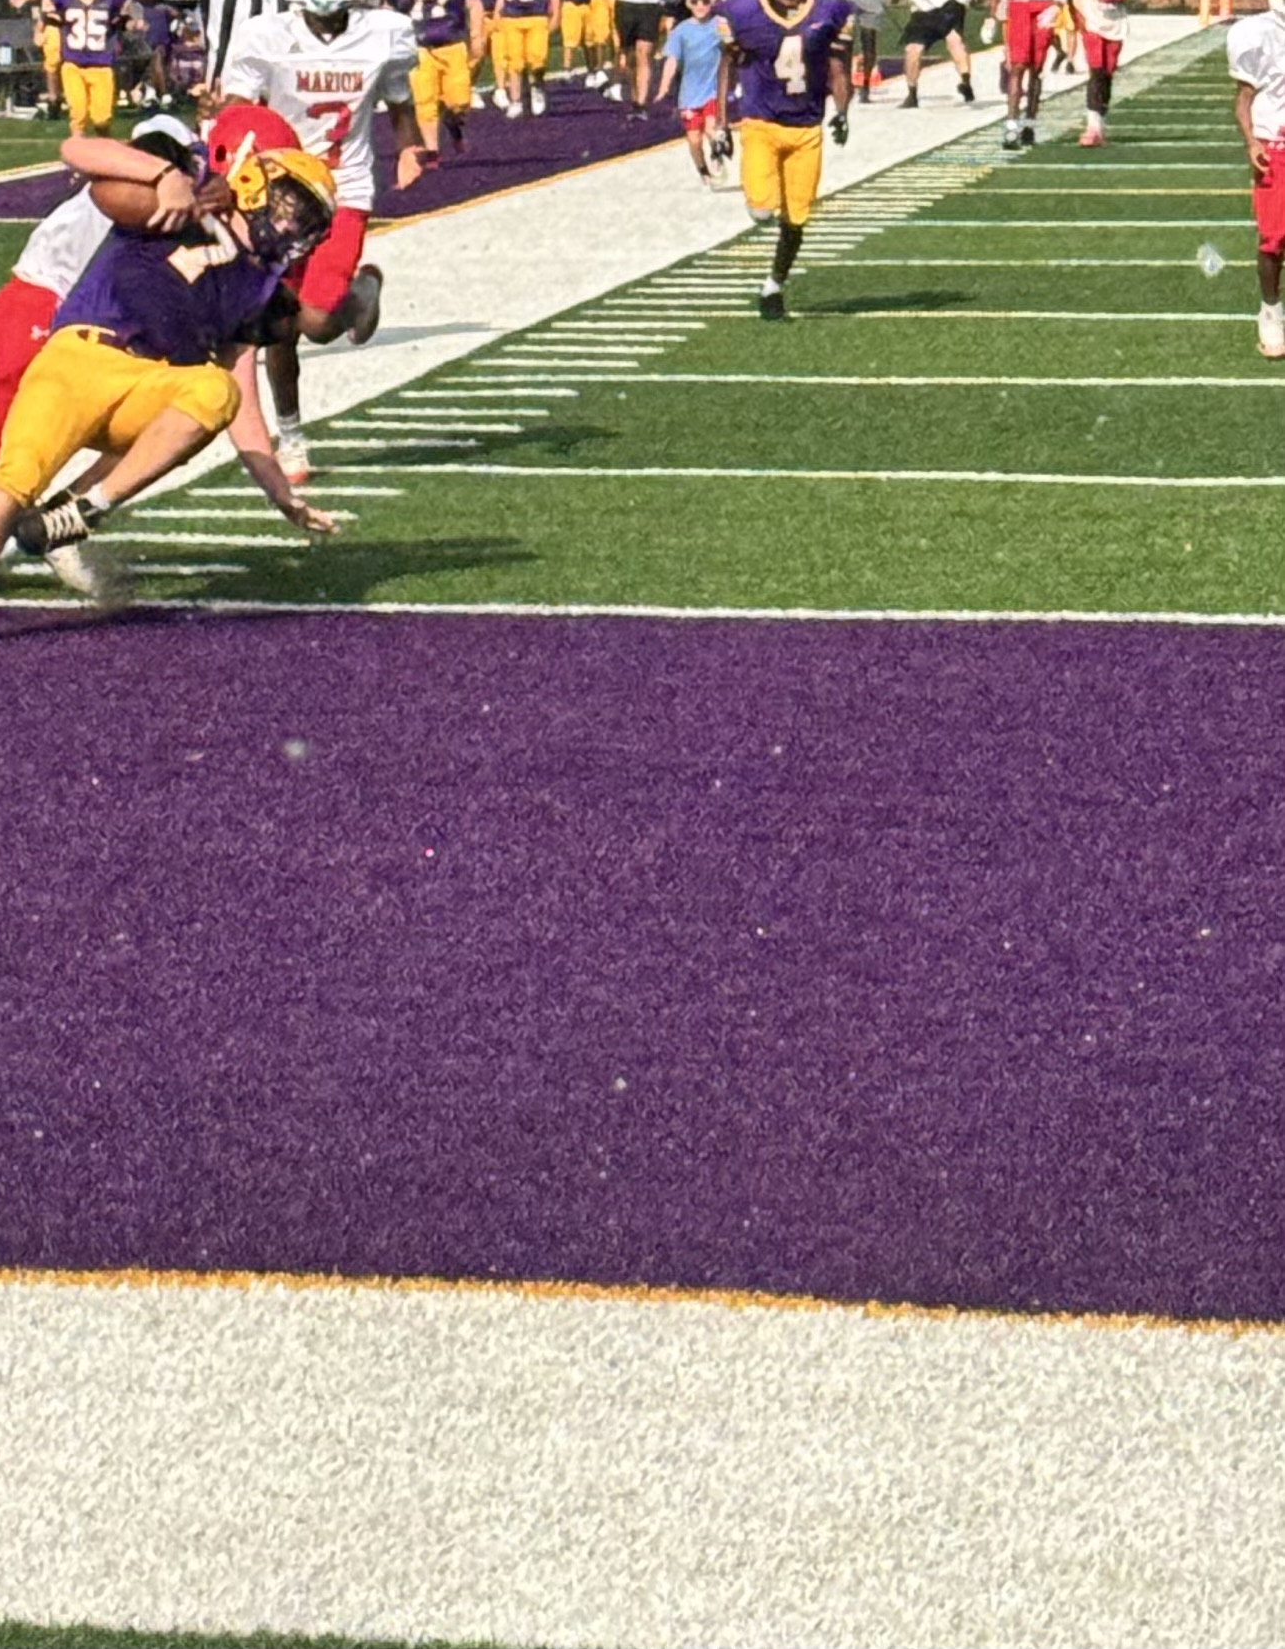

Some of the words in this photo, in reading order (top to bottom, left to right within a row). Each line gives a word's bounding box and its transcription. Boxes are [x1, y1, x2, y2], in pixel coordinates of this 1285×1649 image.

[65, 7, 109, 52] 35
[773, 18, 807, 95] 4
[295, 69, 364, 93] MARION
